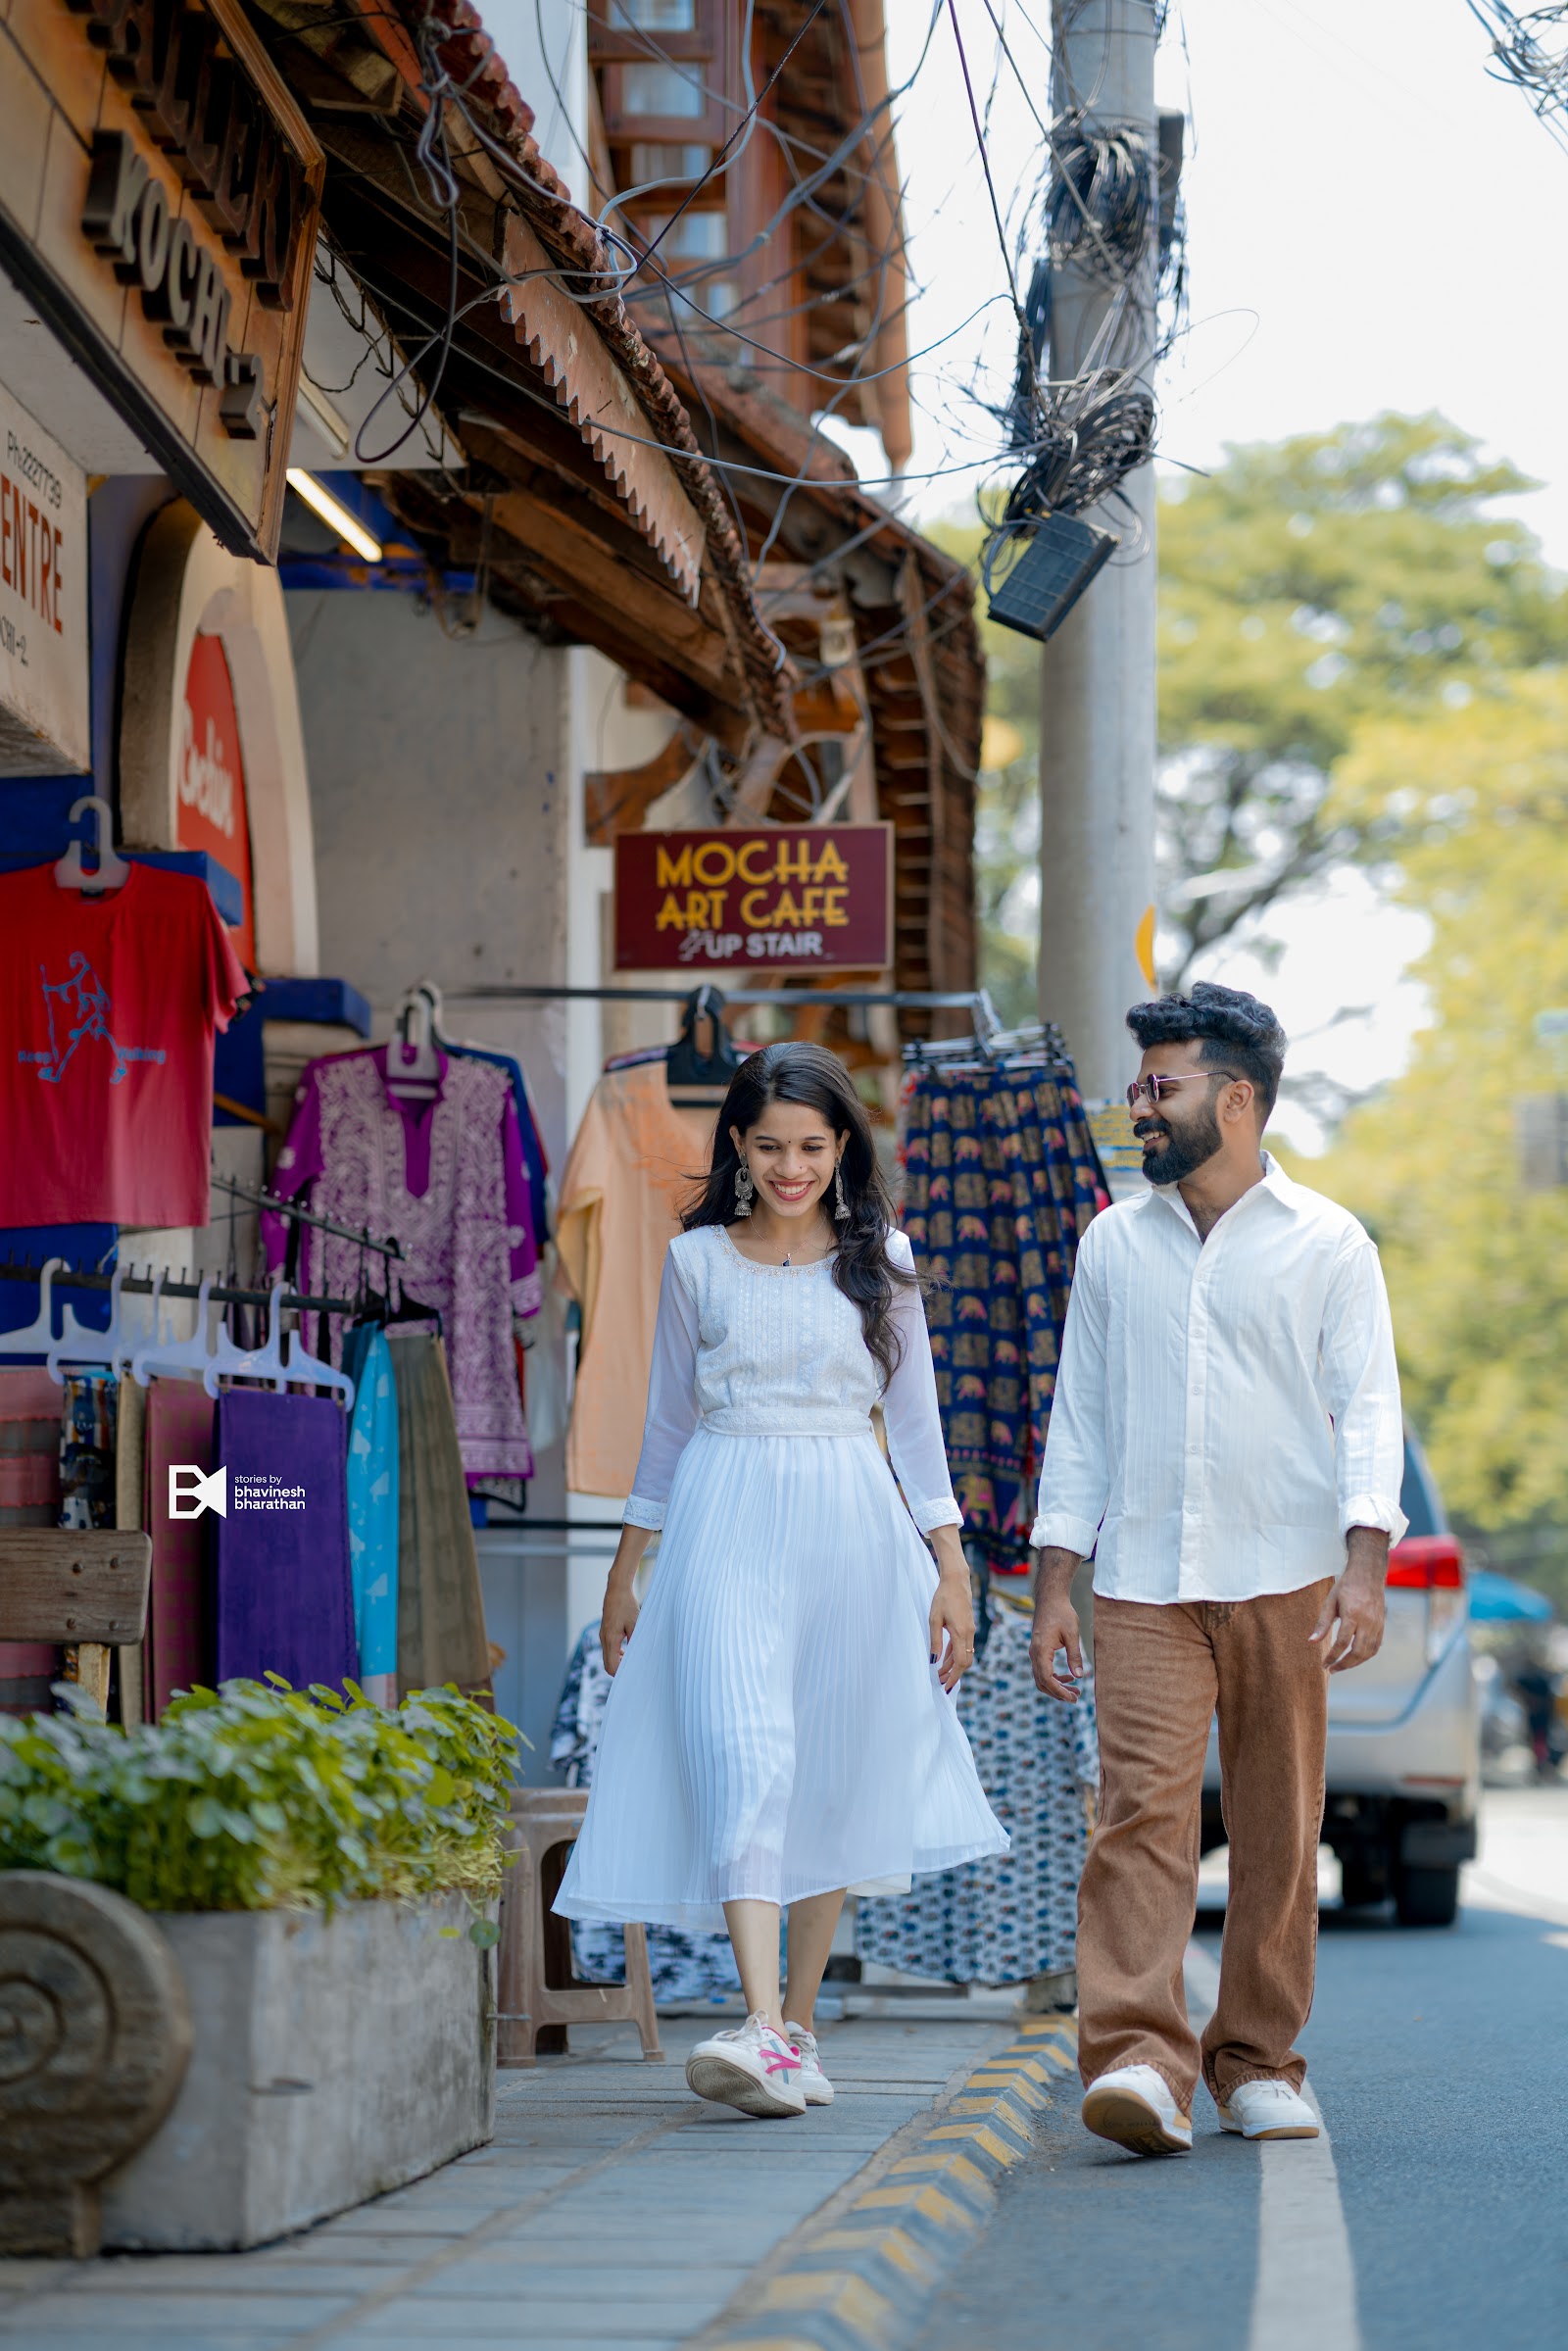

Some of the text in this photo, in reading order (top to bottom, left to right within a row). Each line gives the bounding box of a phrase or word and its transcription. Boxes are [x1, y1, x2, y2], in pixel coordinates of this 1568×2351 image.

[88, 0, 316, 312] ALLERY
[1, 472, 64, 637] ENTRE
[657, 838, 849, 888] MOCHA
[656, 886, 850, 931] ART CAFE
[705, 931, 823, 958] UP STAIR
[18, 1051, 52, 1065] Keep
